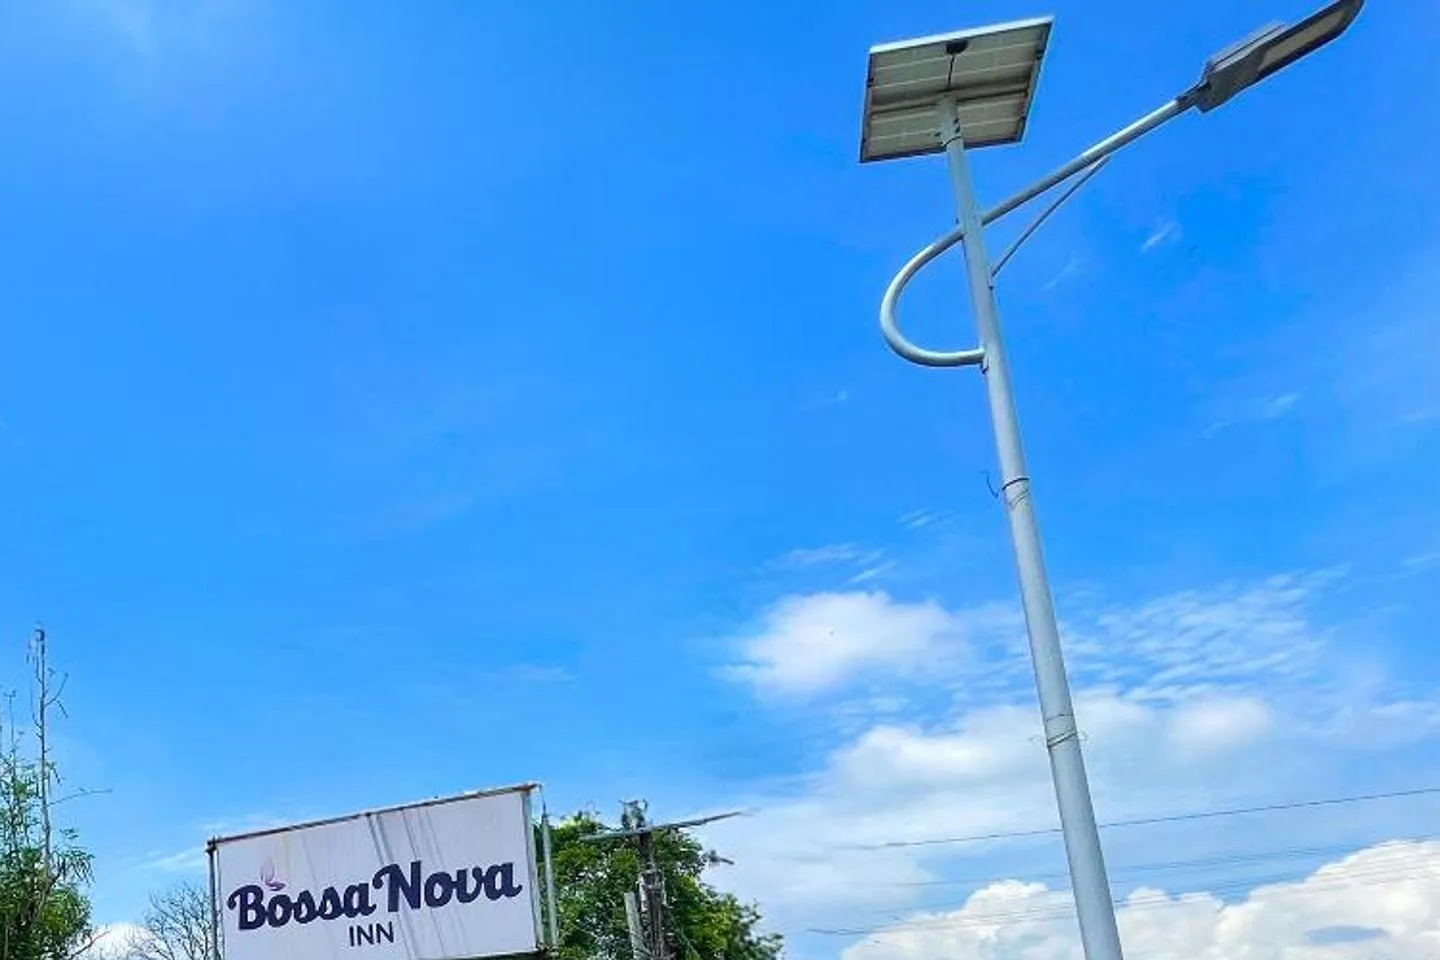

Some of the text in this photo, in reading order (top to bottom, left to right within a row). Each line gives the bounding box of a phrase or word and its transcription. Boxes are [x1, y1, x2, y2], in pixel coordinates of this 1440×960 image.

[227, 860, 522, 930] Bossa Nova
[349, 921, 394, 947] INN
